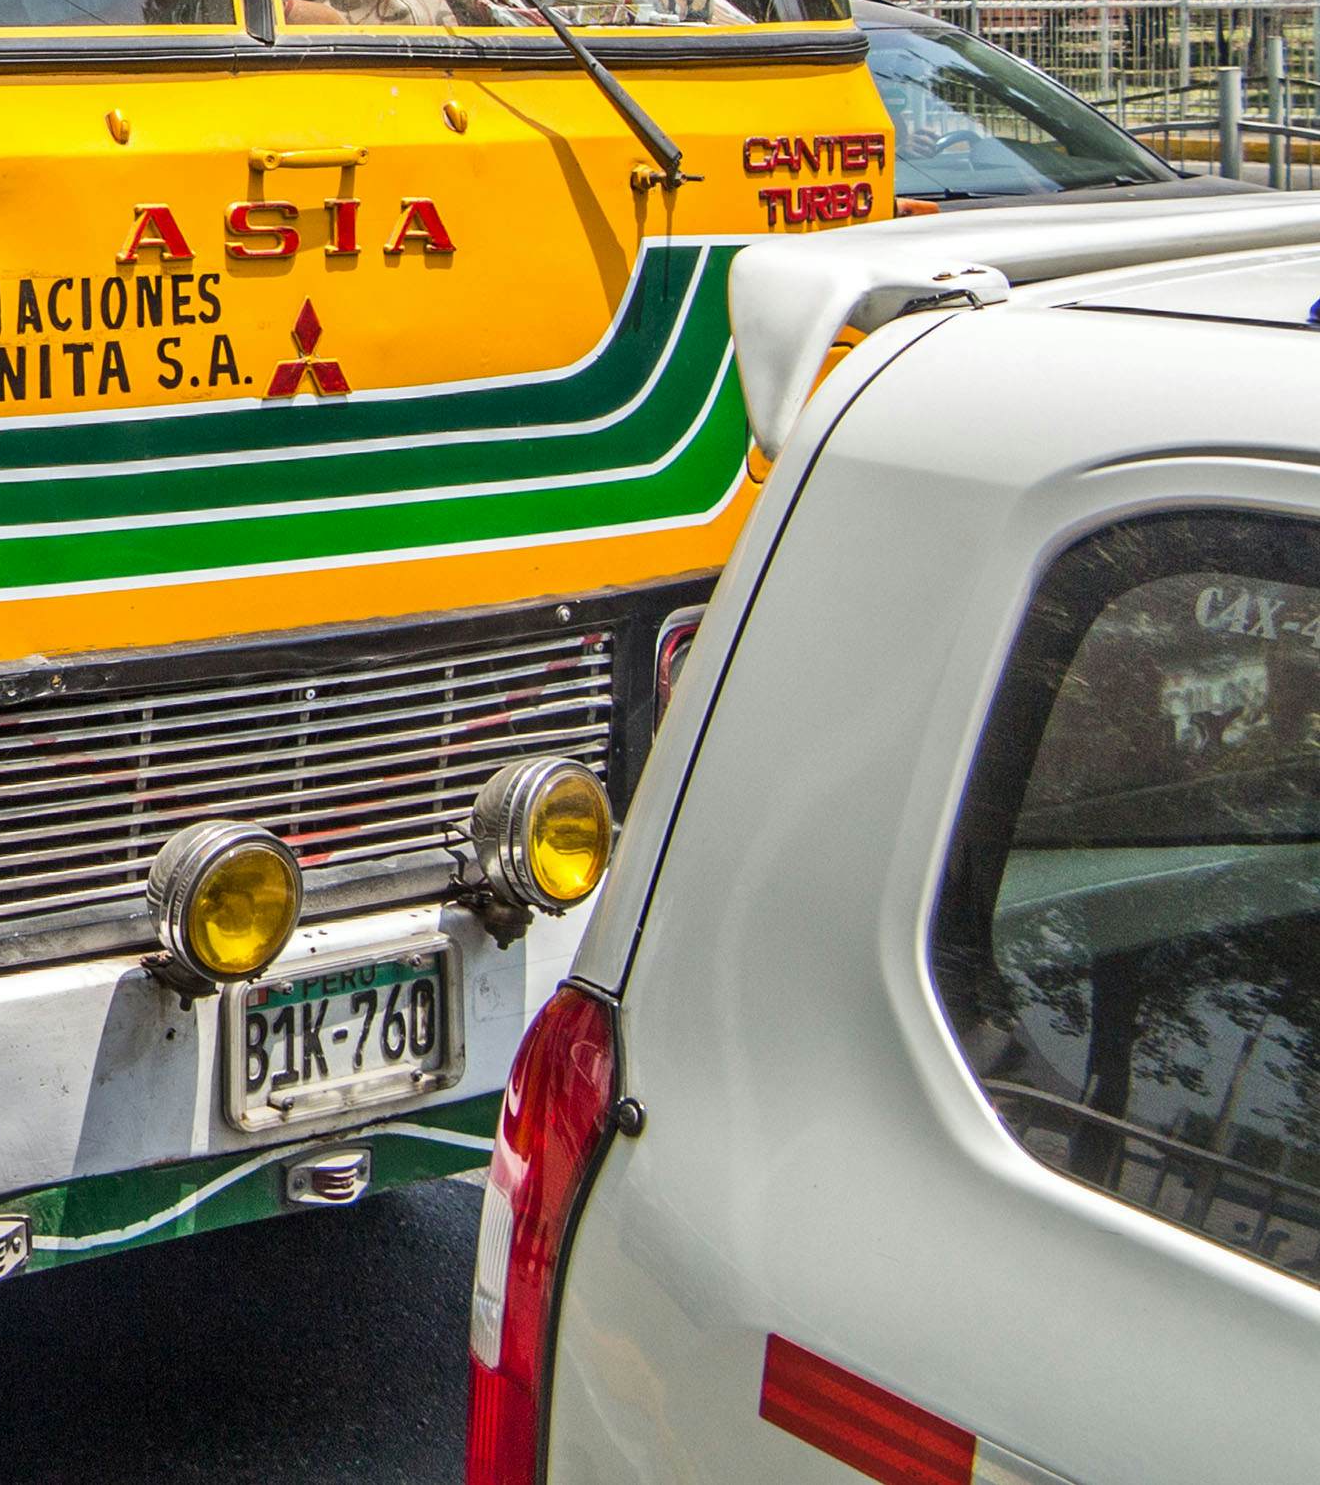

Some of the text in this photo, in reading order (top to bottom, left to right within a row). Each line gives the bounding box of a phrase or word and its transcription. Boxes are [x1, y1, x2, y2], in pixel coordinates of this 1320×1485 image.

[743, 134, 885, 172] CANTER
[116, 196, 456, 263] ASIA
[758, 182, 873, 226] TURBO
[158, 336, 254, 390] S.A.
[246, 978, 435, 1093] B1K-760
